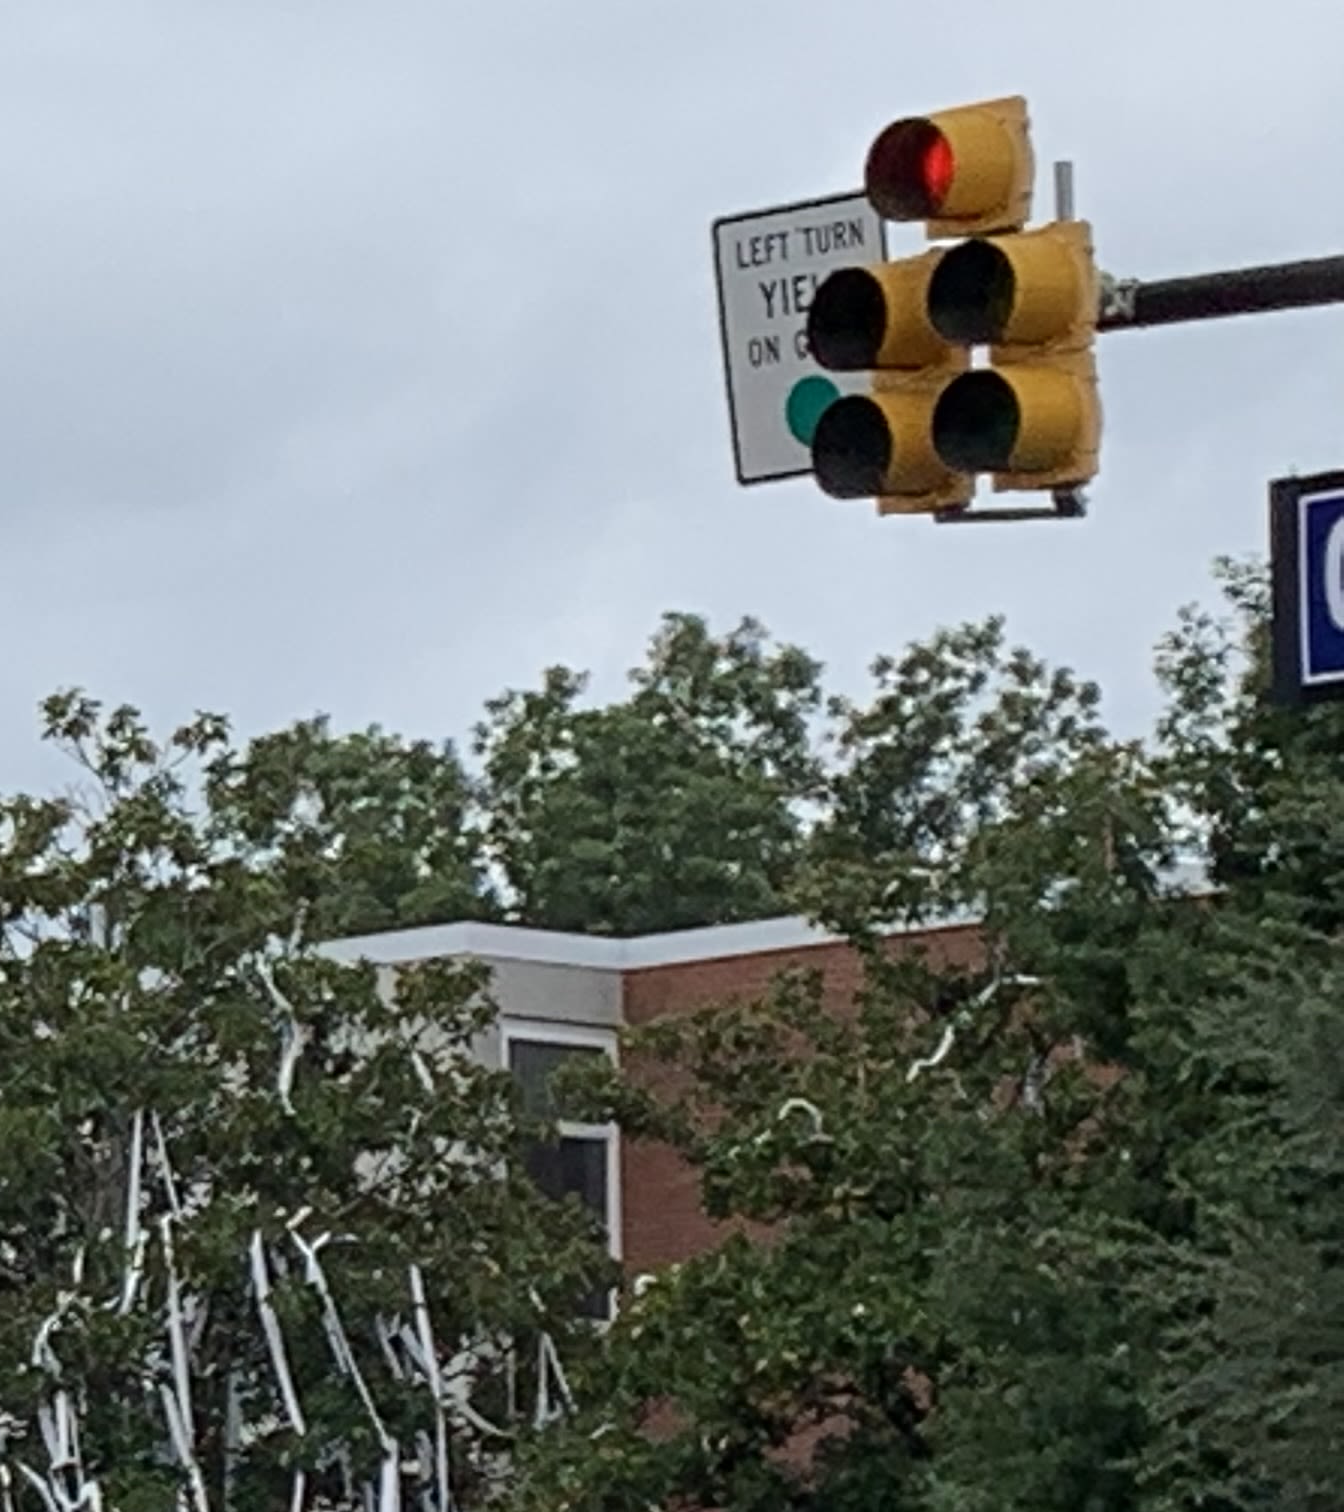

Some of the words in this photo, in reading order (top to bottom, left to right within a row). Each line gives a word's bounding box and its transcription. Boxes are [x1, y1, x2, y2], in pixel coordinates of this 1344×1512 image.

[736, 231, 789, 269] LEFT
[795, 218, 865, 256] TURN
[758, 274, 818, 319] YIE
[748, 335, 781, 368] ON
